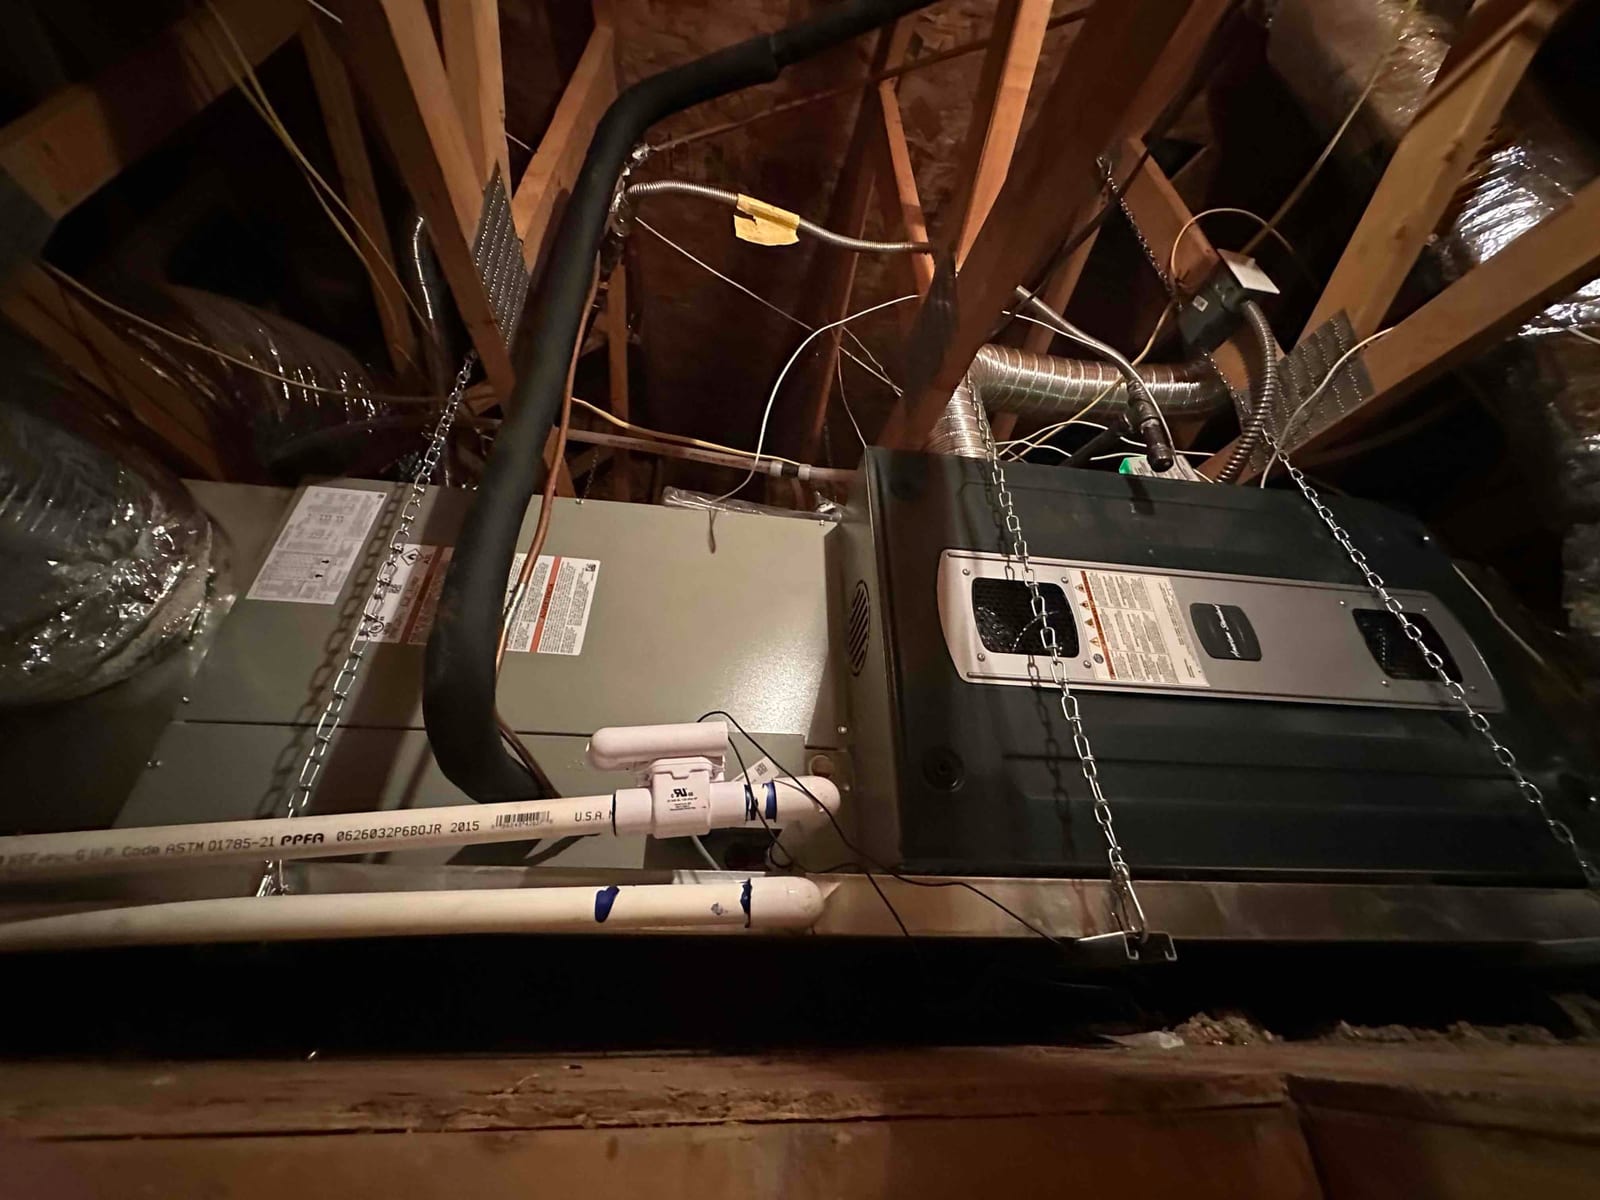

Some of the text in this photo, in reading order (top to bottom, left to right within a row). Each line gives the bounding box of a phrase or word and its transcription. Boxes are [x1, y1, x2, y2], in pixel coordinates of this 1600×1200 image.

[165, 841, 205, 854] ASTM
[281, 833, 325, 846] PPFA
[450, 820, 480, 833] 2015
